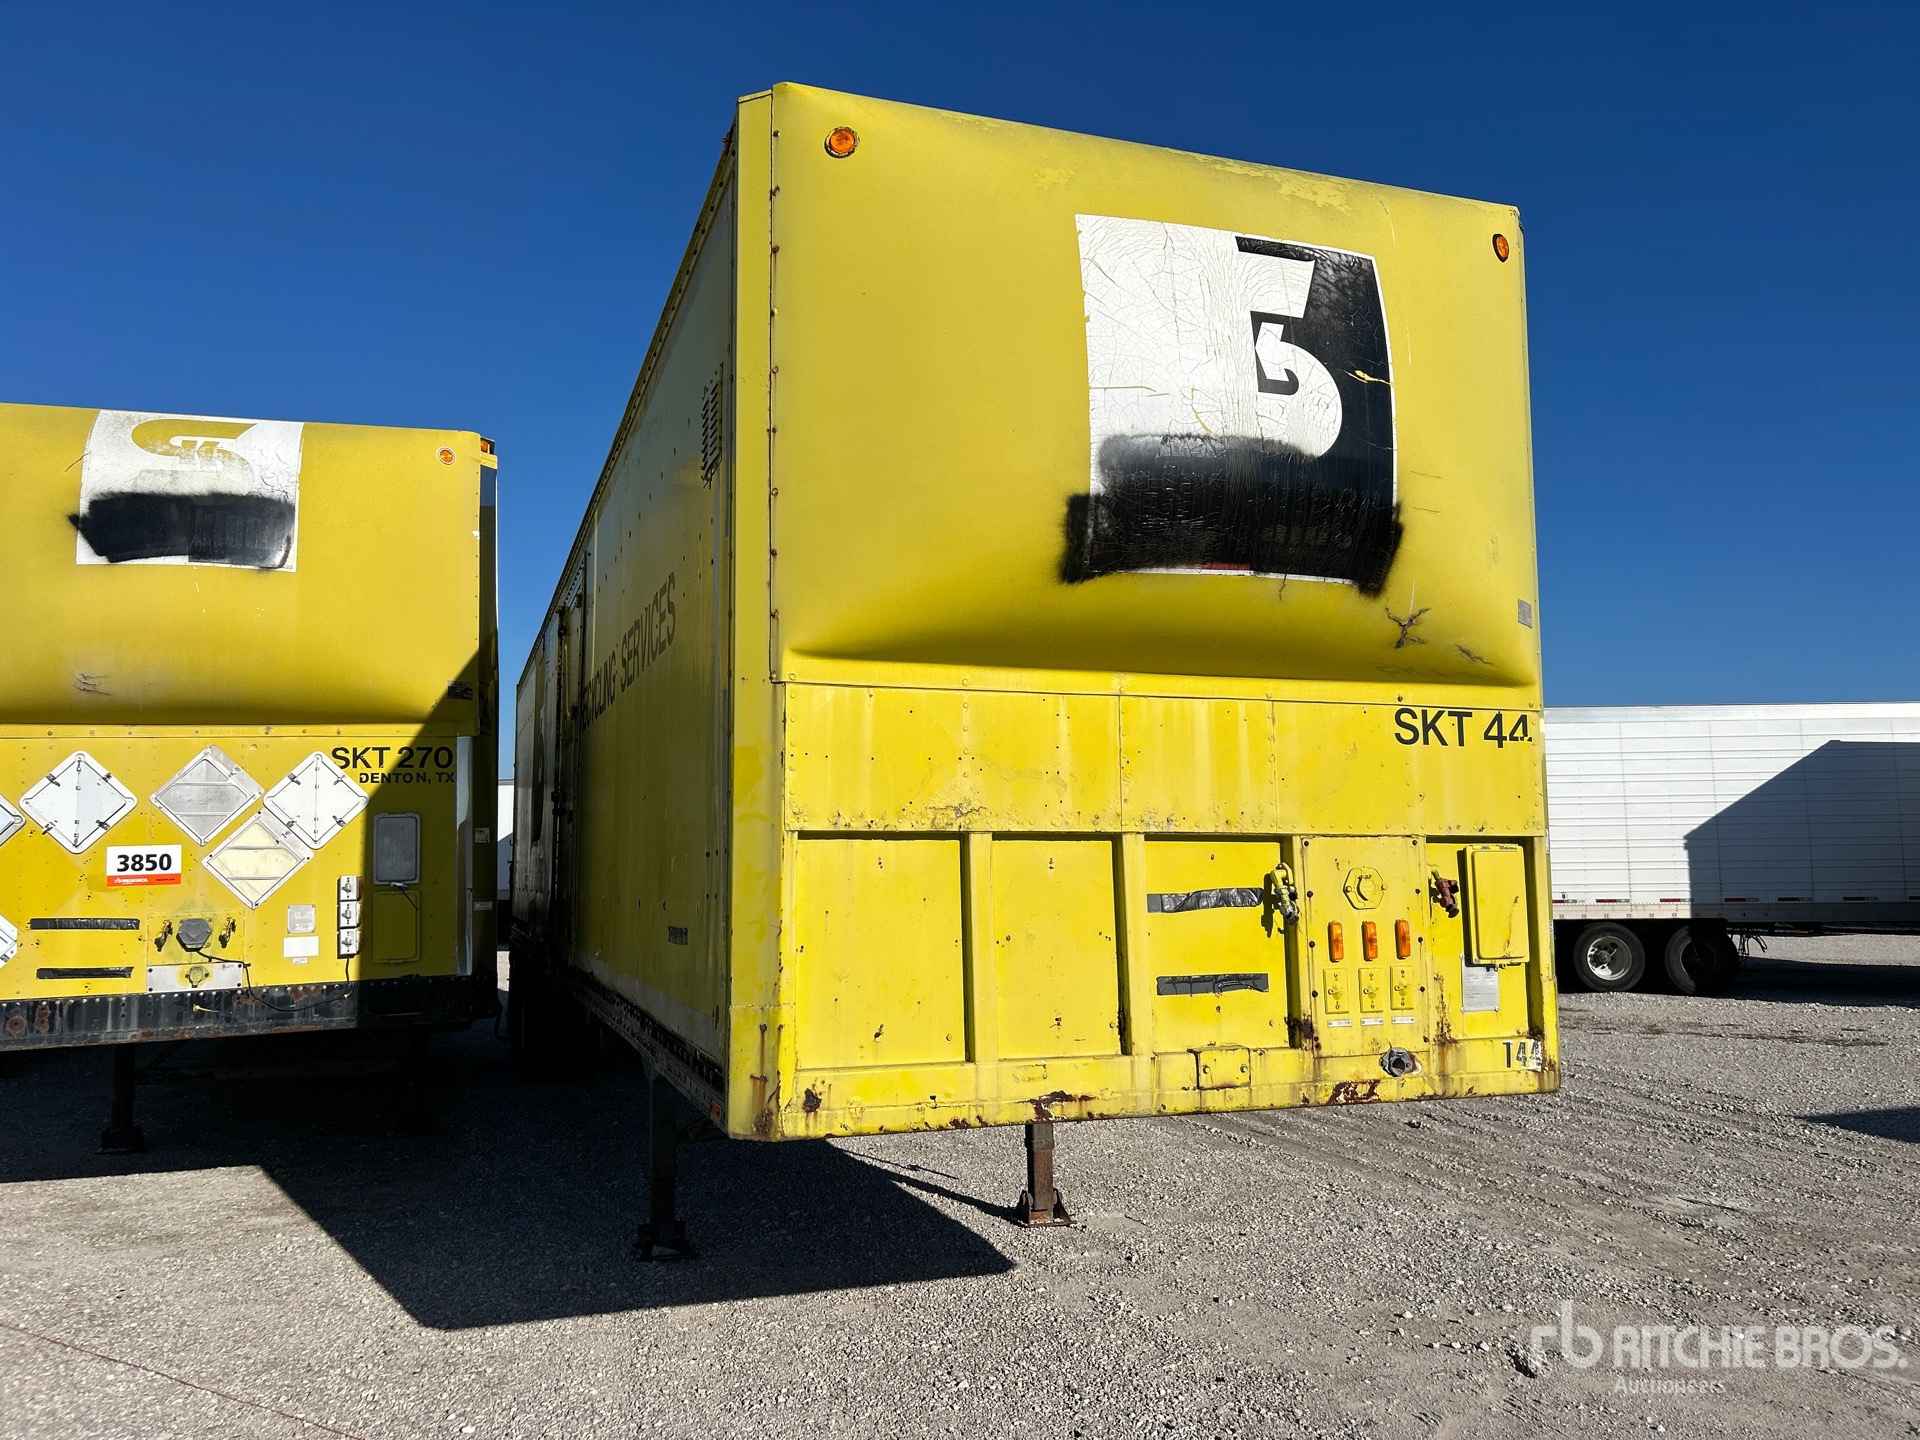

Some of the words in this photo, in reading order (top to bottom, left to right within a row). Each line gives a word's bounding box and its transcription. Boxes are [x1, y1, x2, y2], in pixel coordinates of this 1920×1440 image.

[620, 571, 676, 694] SERVICES
[1394, 707, 1474, 748] SKT
[331, 746, 391, 770] SKT
[397, 746, 454, 770] 270
[359, 772, 432, 785] DENTON,
[435, 772, 455, 784] TX
[116, 853, 172, 872] 3850
